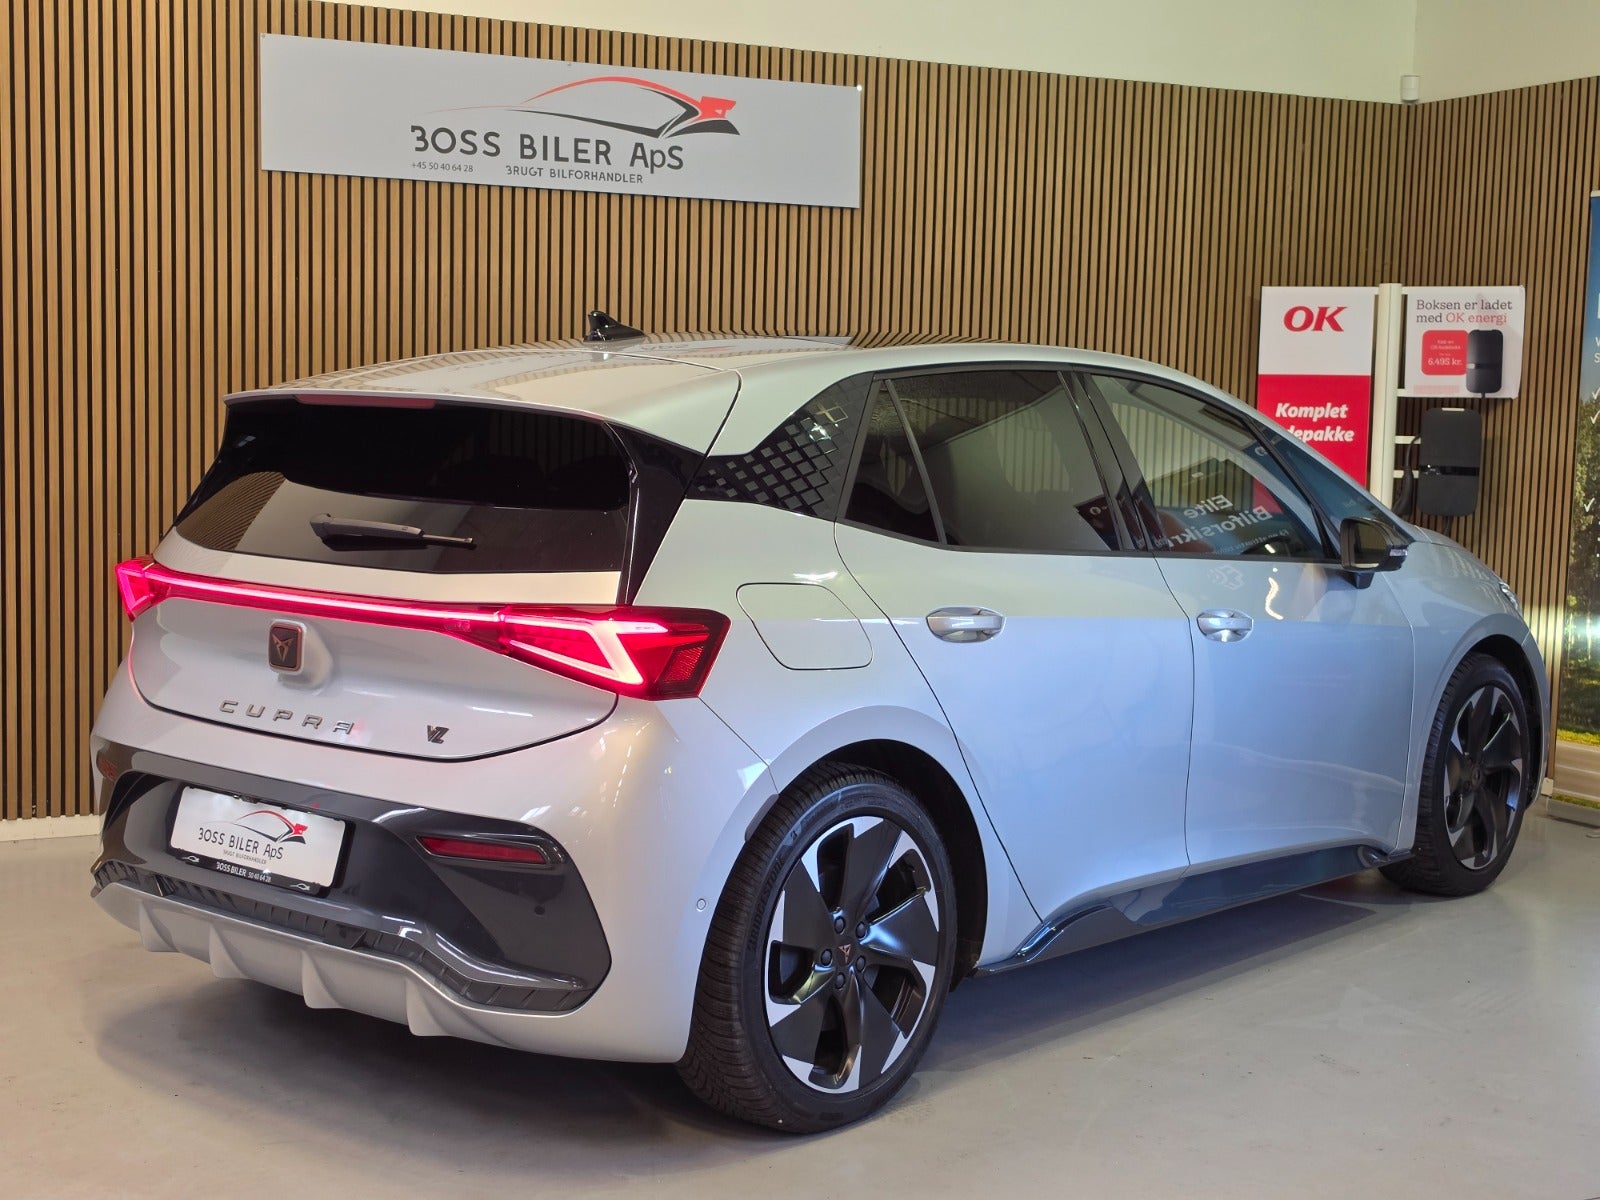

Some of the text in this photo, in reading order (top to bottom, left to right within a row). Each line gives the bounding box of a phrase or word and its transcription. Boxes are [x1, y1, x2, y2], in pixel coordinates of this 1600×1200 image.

[519, 133, 612, 166] BILER
[629, 142, 684, 174] ApS
[412, 161, 474, 173] +45 50 40 64 28
[549, 168, 643, 184] BILFORHANDLER
[1416, 299, 1513, 310] Boksen er ladet
[1283, 305, 1348, 332] OK
[1416, 312, 1508, 326] med OK energi
[1275, 402, 1349, 422] Komplet
[219, 699, 354, 735] CUPRA
[426, 724, 450, 744] VZ
[228, 834, 260, 854] BILER
[262, 843, 284, 860] ApS
[230, 865, 247, 877] BILER
